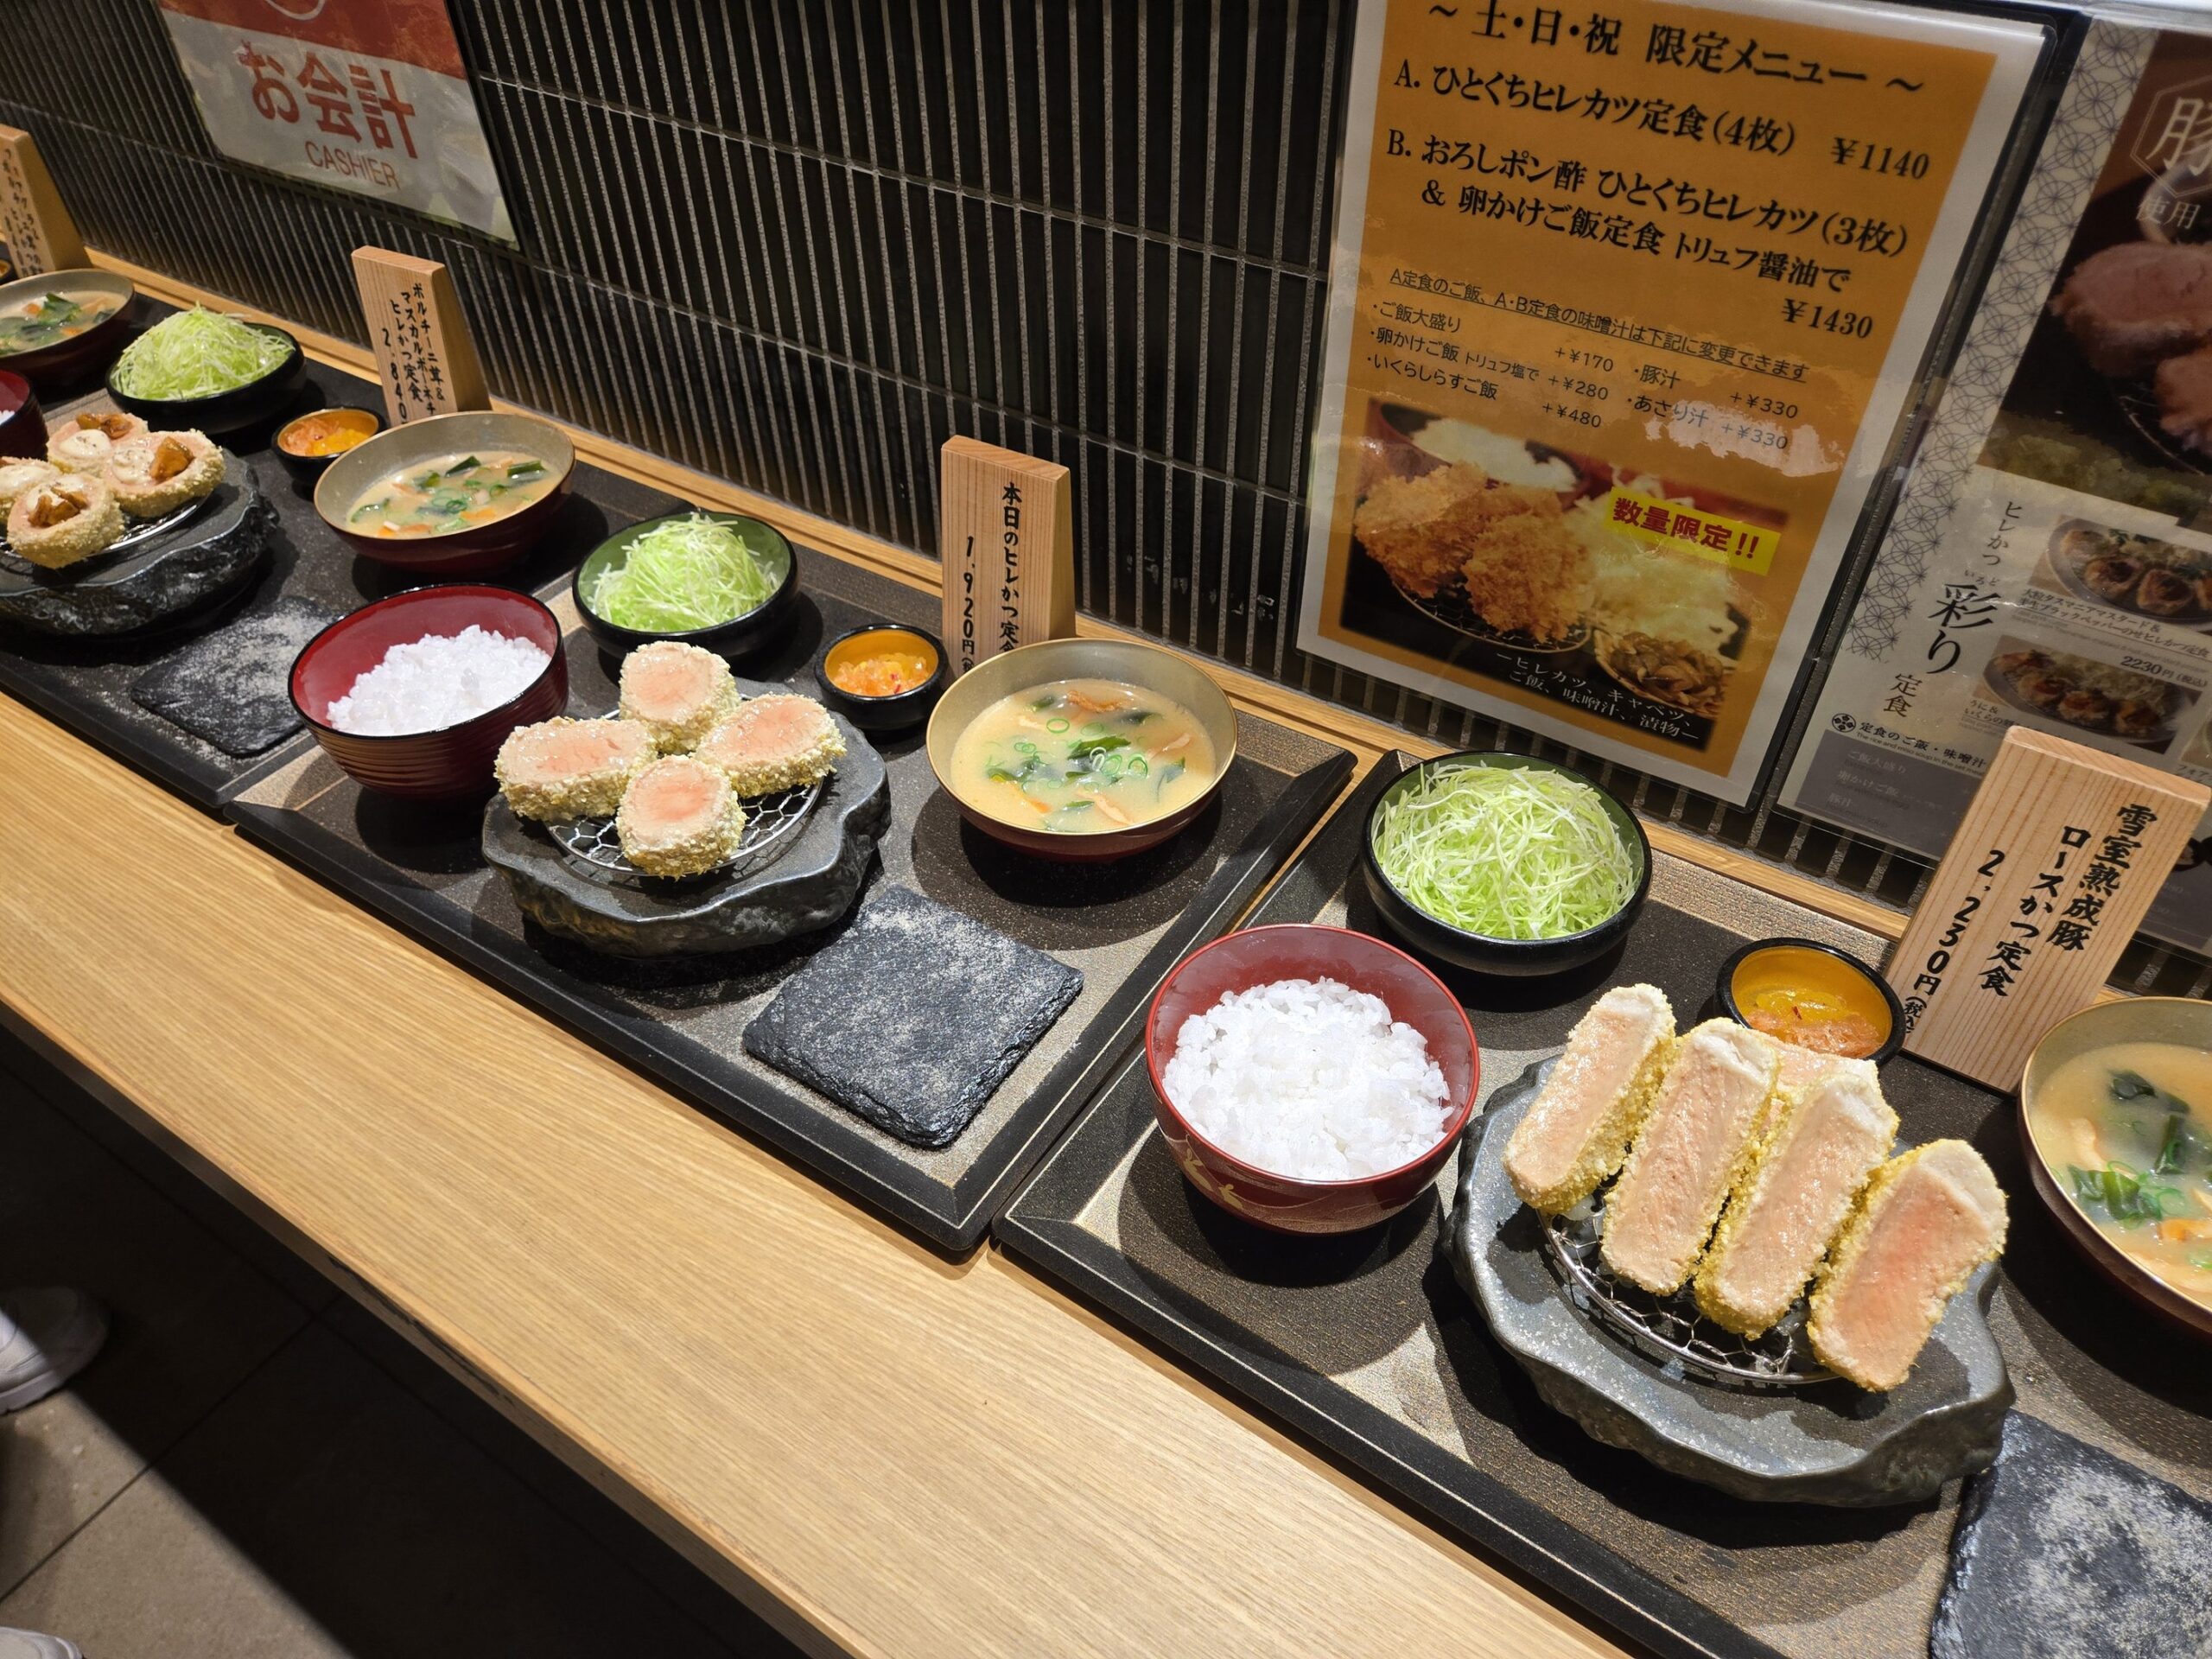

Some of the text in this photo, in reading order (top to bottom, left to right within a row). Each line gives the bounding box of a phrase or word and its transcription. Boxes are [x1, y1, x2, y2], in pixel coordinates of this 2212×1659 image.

[238, 40, 417, 159] お会計
[1645, 23, 1868, 85] 限定メニュー
[1387, 129, 1411, 156] B.
[1421, 134, 1587, 193] おろしポン酢
[1394, 59, 1421, 87] A.
[1831, 137, 1929, 180] ¥1140
[305, 141, 401, 190] CASHIER
[1421, 179, 1851, 292] & 卵かけご飯定食 トリュフ醤油で
[391, 299, 423, 403] ヒレかつ定食
[1782, 297, 1873, 340] ¥1430
[382, 328, 407, 424] 2,840
[1612, 496, 1761, 560] 数量限定!!
[1983, 501, 2022, 566] ヒレかつ
[1926, 583, 2001, 674] 彩り
[1884, 673, 1923, 717] 定食
[1979, 825, 2091, 996] ロースかつ定食
[2047, 804, 2157, 951] 雪室熟成豚
